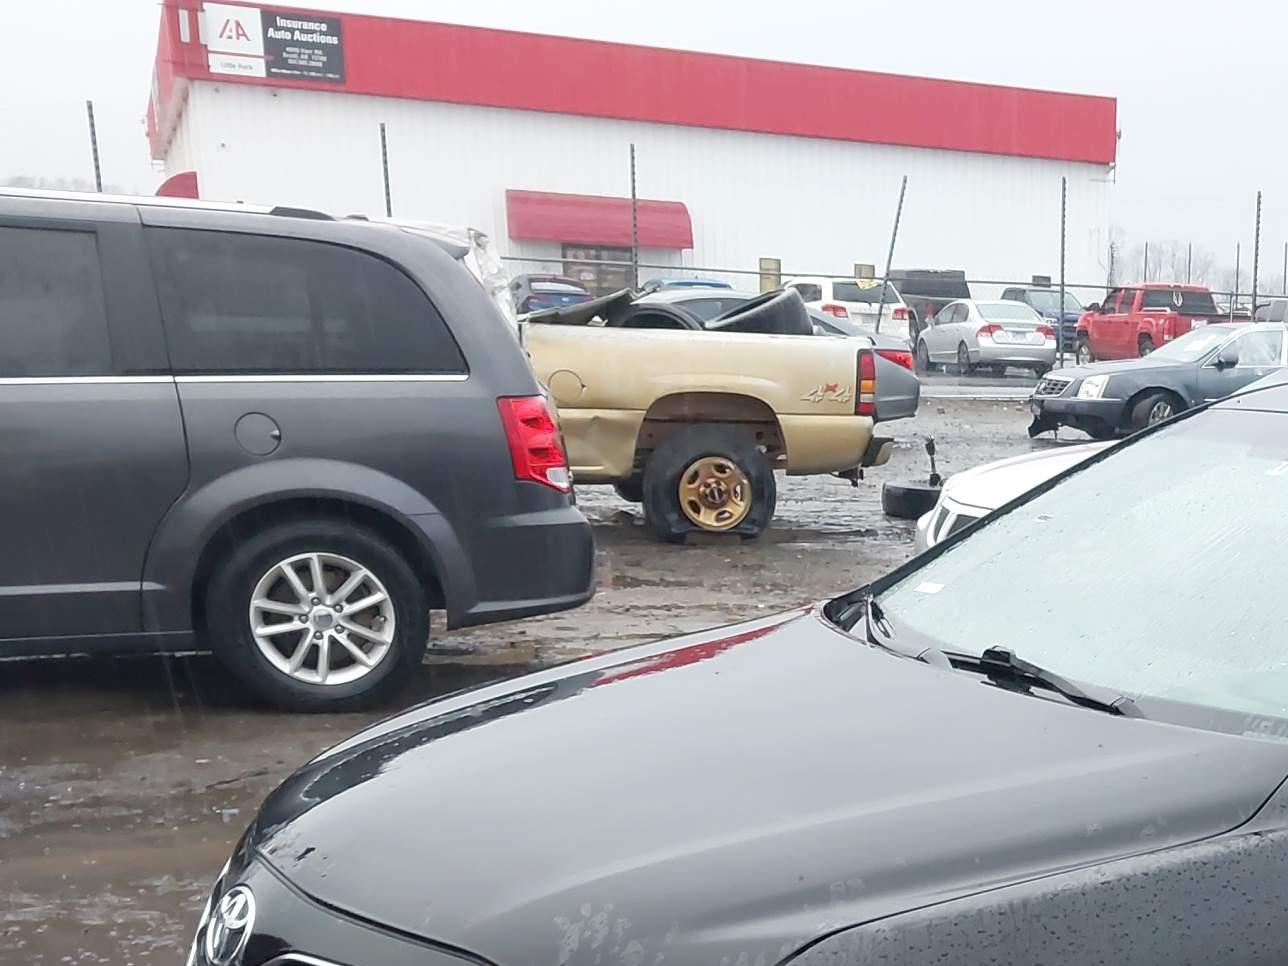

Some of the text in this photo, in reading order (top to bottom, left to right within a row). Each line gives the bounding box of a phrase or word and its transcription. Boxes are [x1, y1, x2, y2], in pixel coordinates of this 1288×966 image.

[276, 15, 328, 32] Insurance
[267, 27, 339, 45] Auto Auctions
